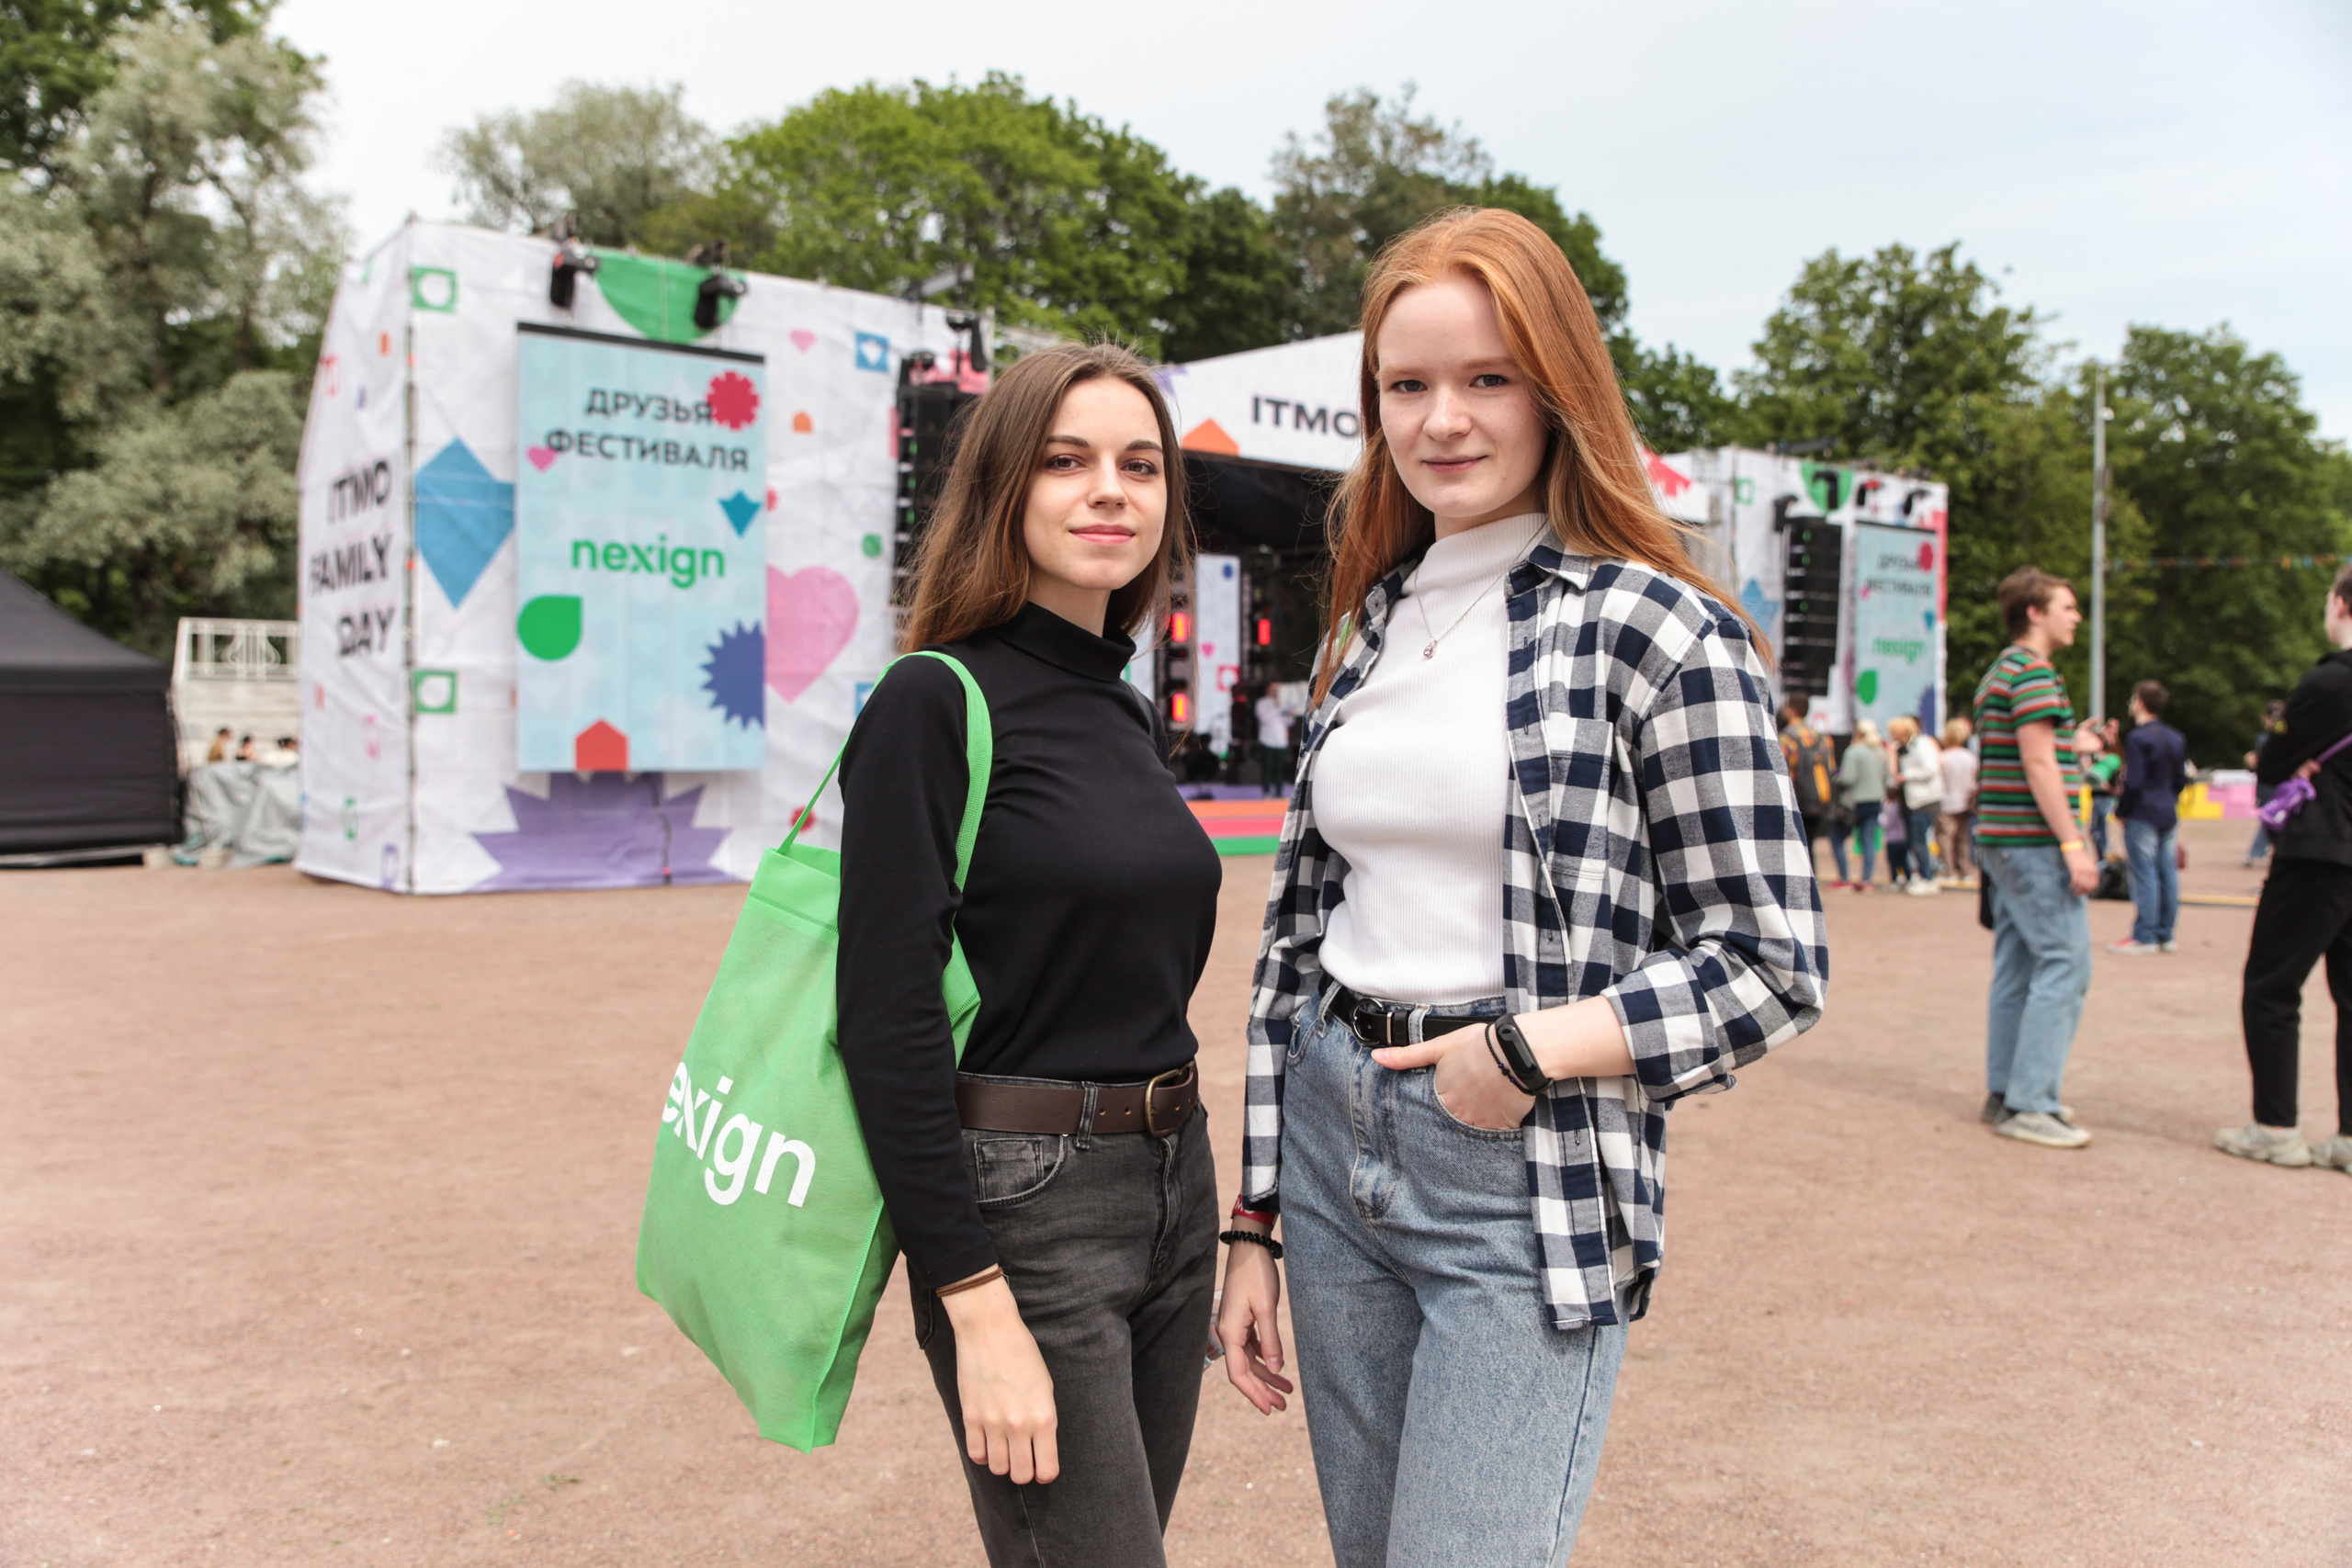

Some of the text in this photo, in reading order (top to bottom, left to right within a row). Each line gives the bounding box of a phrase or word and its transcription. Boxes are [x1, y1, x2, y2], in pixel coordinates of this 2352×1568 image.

[585, 388, 712, 424] ДРУЗЬЯ
[1252, 395, 1360, 438] ITMO
[546, 428, 749, 471] ФЕСТИВАЛЯ
[327, 459, 391, 524] ITMO
[308, 532, 393, 594] FAMILY
[571, 534, 725, 590] nexign
[336, 606, 395, 659] DAY
[662, 1061, 816, 1208] exign
